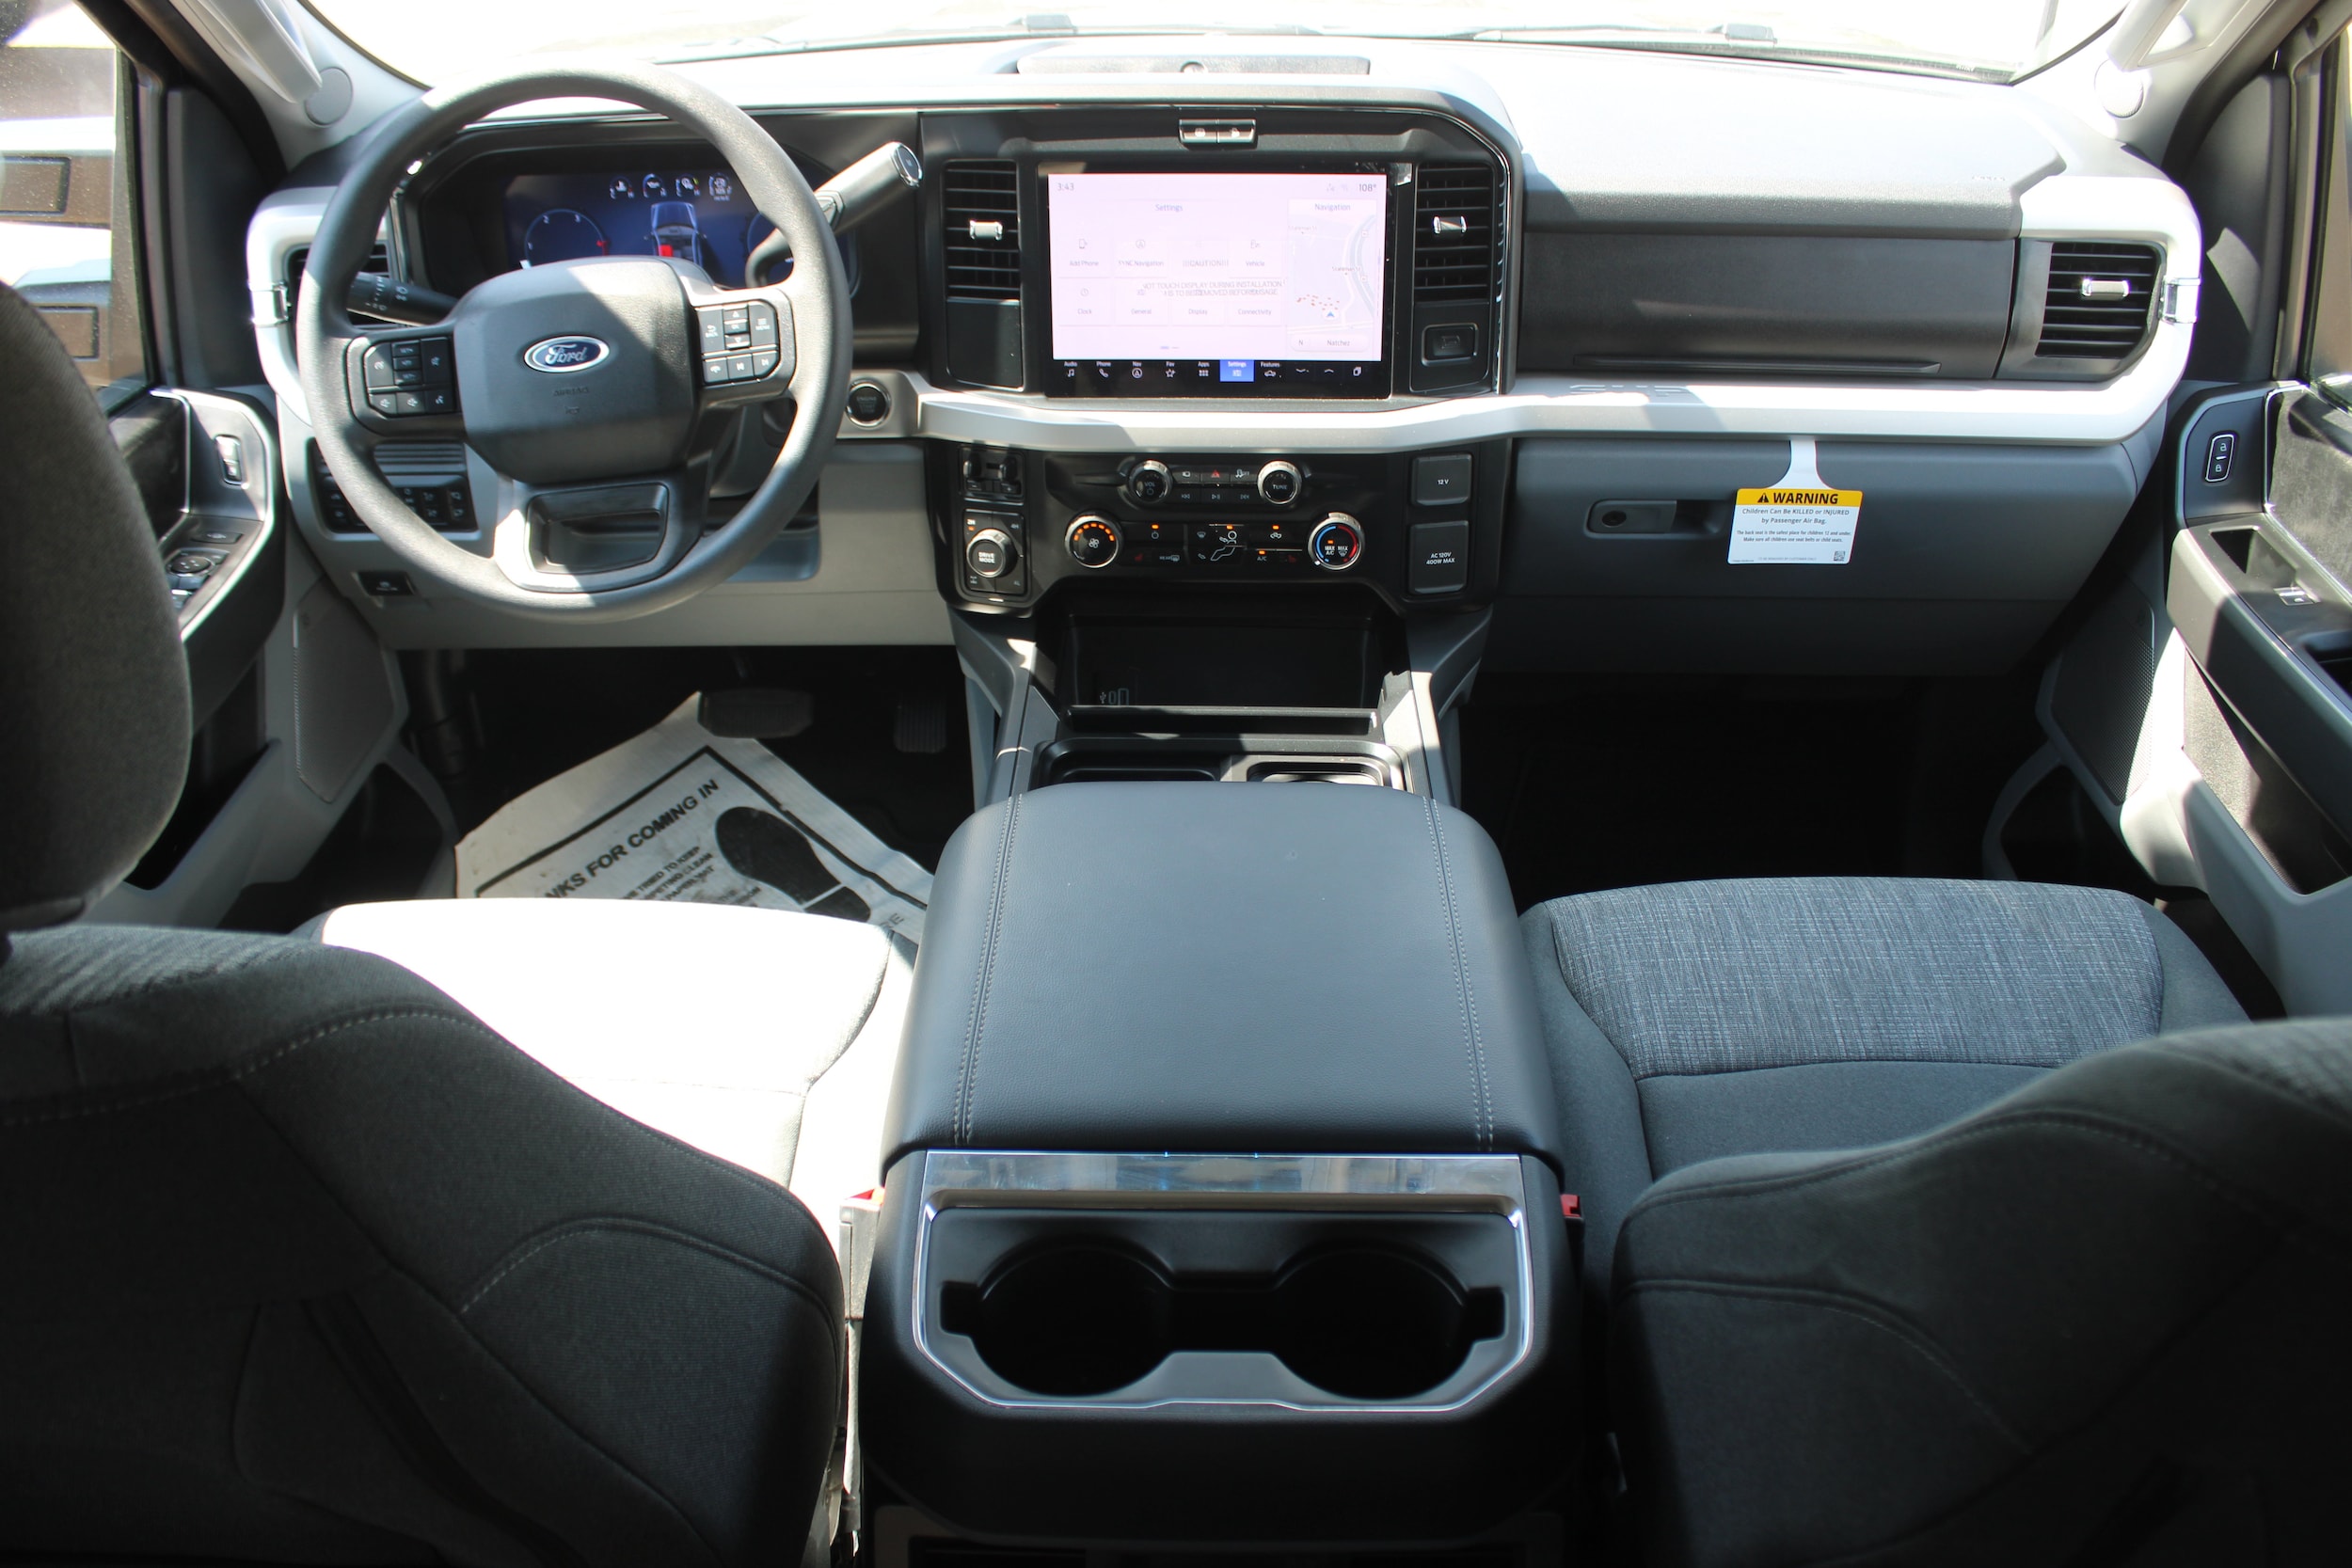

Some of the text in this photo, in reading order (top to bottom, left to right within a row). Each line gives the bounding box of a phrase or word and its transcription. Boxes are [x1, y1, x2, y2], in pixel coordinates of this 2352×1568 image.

[1057, 182, 1074, 191] 3:43
[1154, 203, 1183, 213] Settings
[1314, 202, 1351, 212] Navigation
[1135, 260, 1165, 268] Navigation
[1131, 308, 1152, 316] General
[1188, 308, 1208, 316] Display
[1238, 308, 1271, 317] Connectivity
[545, 342, 588, 366] Ford
[1772, 492, 1838, 505] WARNING
[1823, 508, 1850, 516] INJURED
[585, 845, 628, 877] FOR
[628, 796, 698, 847] COMING
[698, 779, 719, 799] IN
[637, 870, 664, 891] TRIED
[663, 861, 678, 873] TO
[676, 846, 700, 864] KEEP
[684, 852, 713, 876] CLEAN
